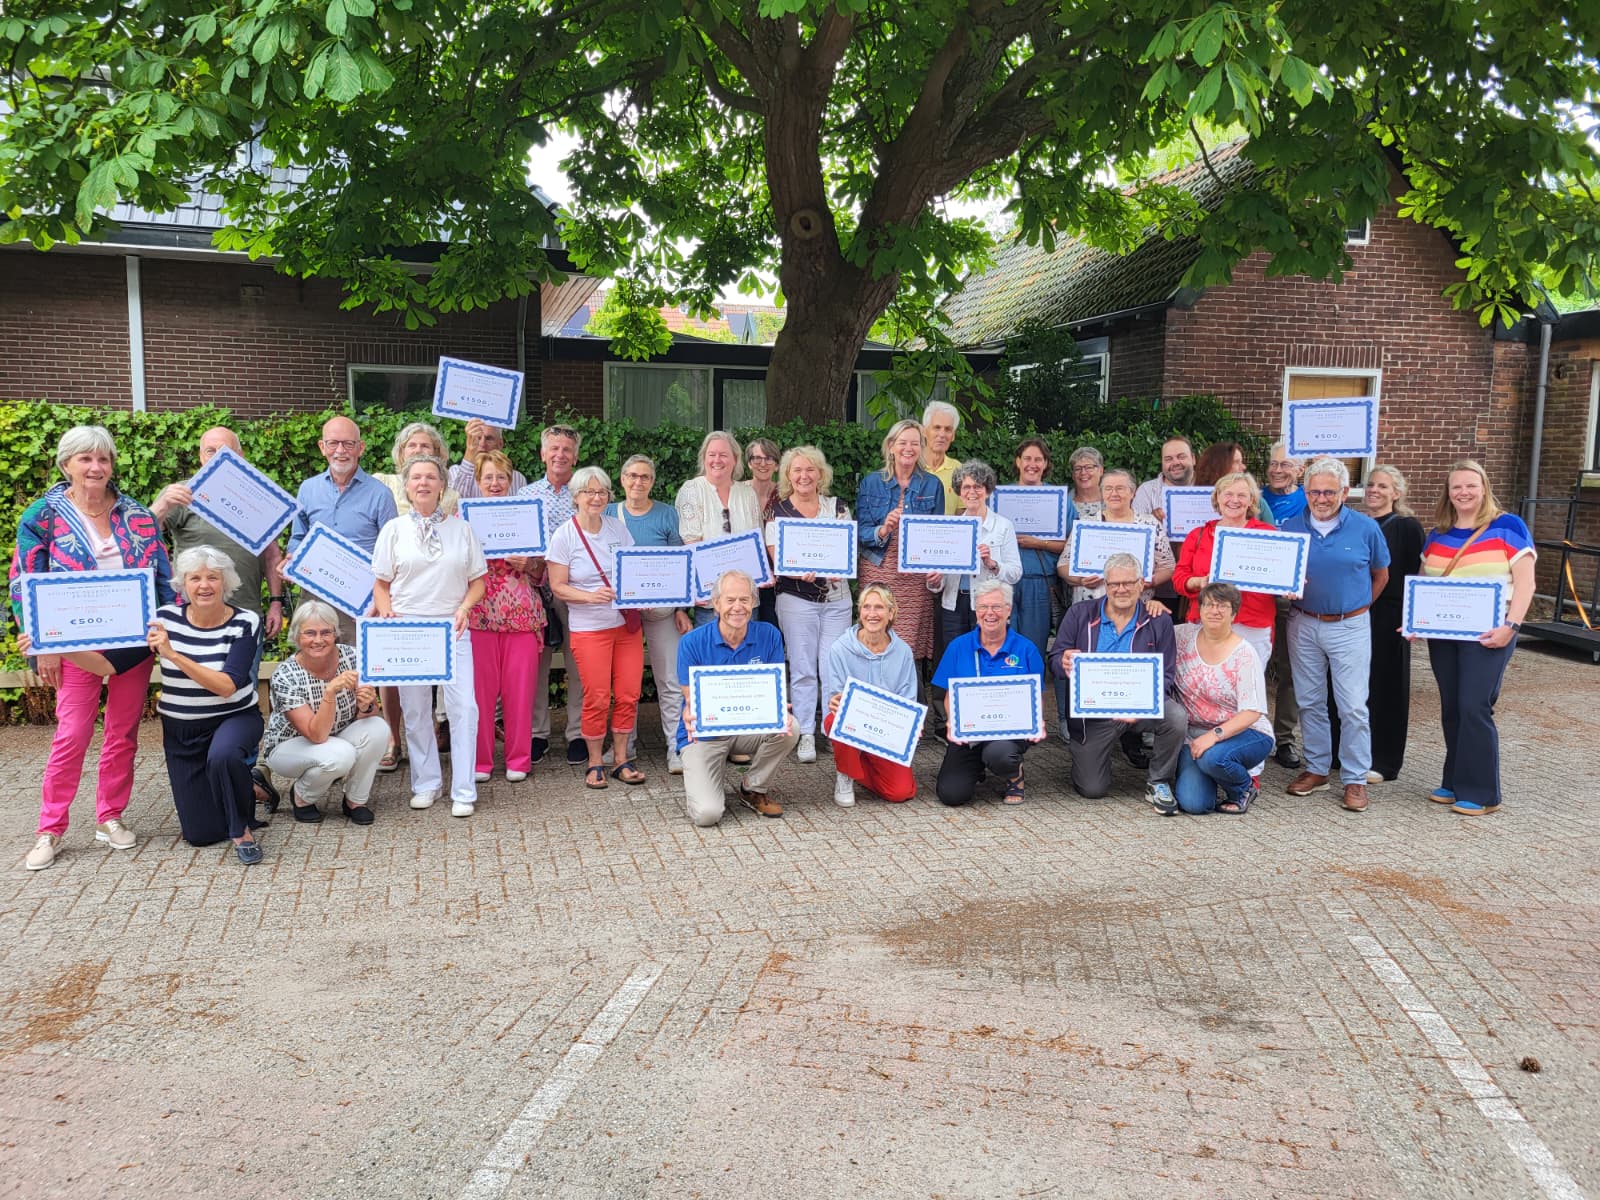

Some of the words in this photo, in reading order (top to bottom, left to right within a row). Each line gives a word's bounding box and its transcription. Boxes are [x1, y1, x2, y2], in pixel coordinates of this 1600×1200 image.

[220, 497, 249, 520] €200,-
[70, 617, 113, 625] €500,-
[387, 656, 428, 664] €1500,-
[720, 705, 760, 713] €2000,-
